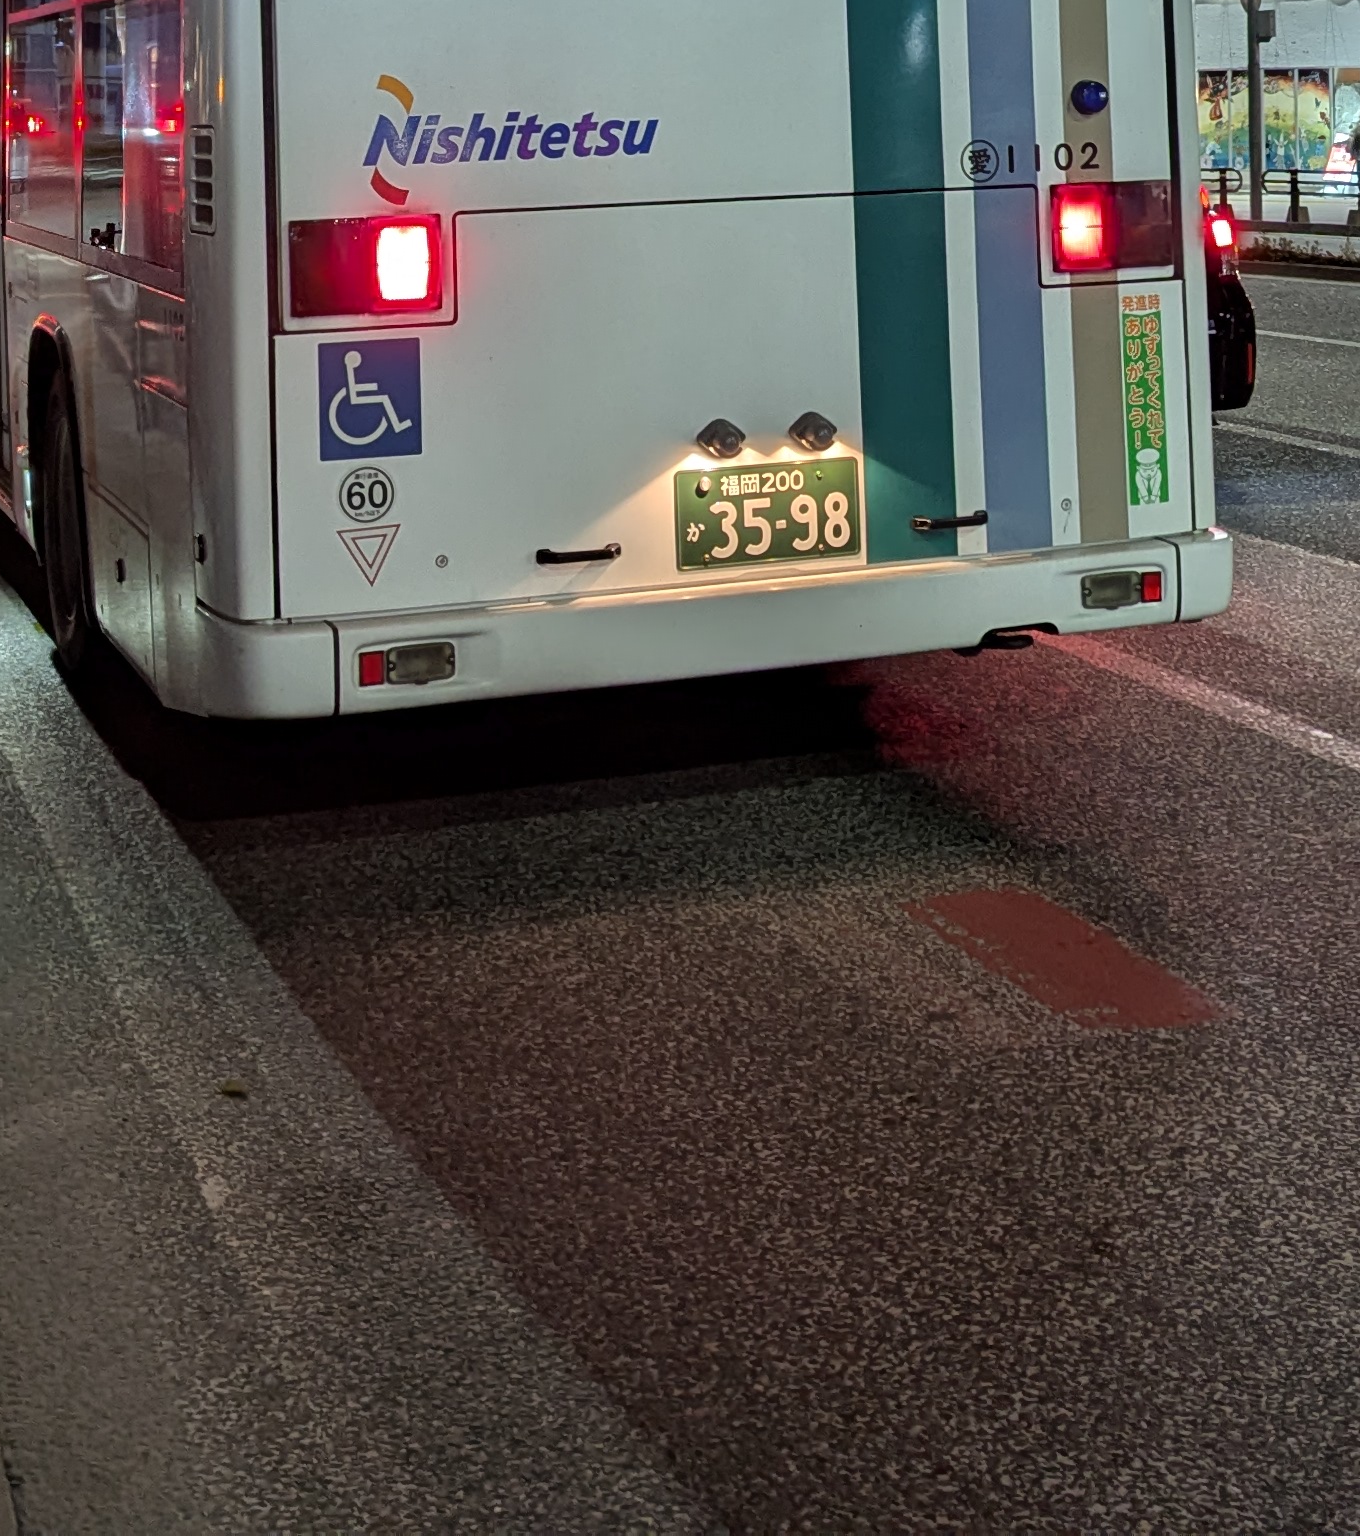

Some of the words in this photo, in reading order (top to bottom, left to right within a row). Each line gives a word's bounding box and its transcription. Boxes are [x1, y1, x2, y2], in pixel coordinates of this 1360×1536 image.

[364, 109, 660, 168] Nishitetsu
[1008, 141, 1100, 174] 1102
[1142, 314, 1165, 449] ゆずってくれて
[347, 479, 388, 511] 60
[720, 469, 804, 497] 福岡200
[686, 522, 705, 543] か
[709, 491, 851, 559] 35-98
